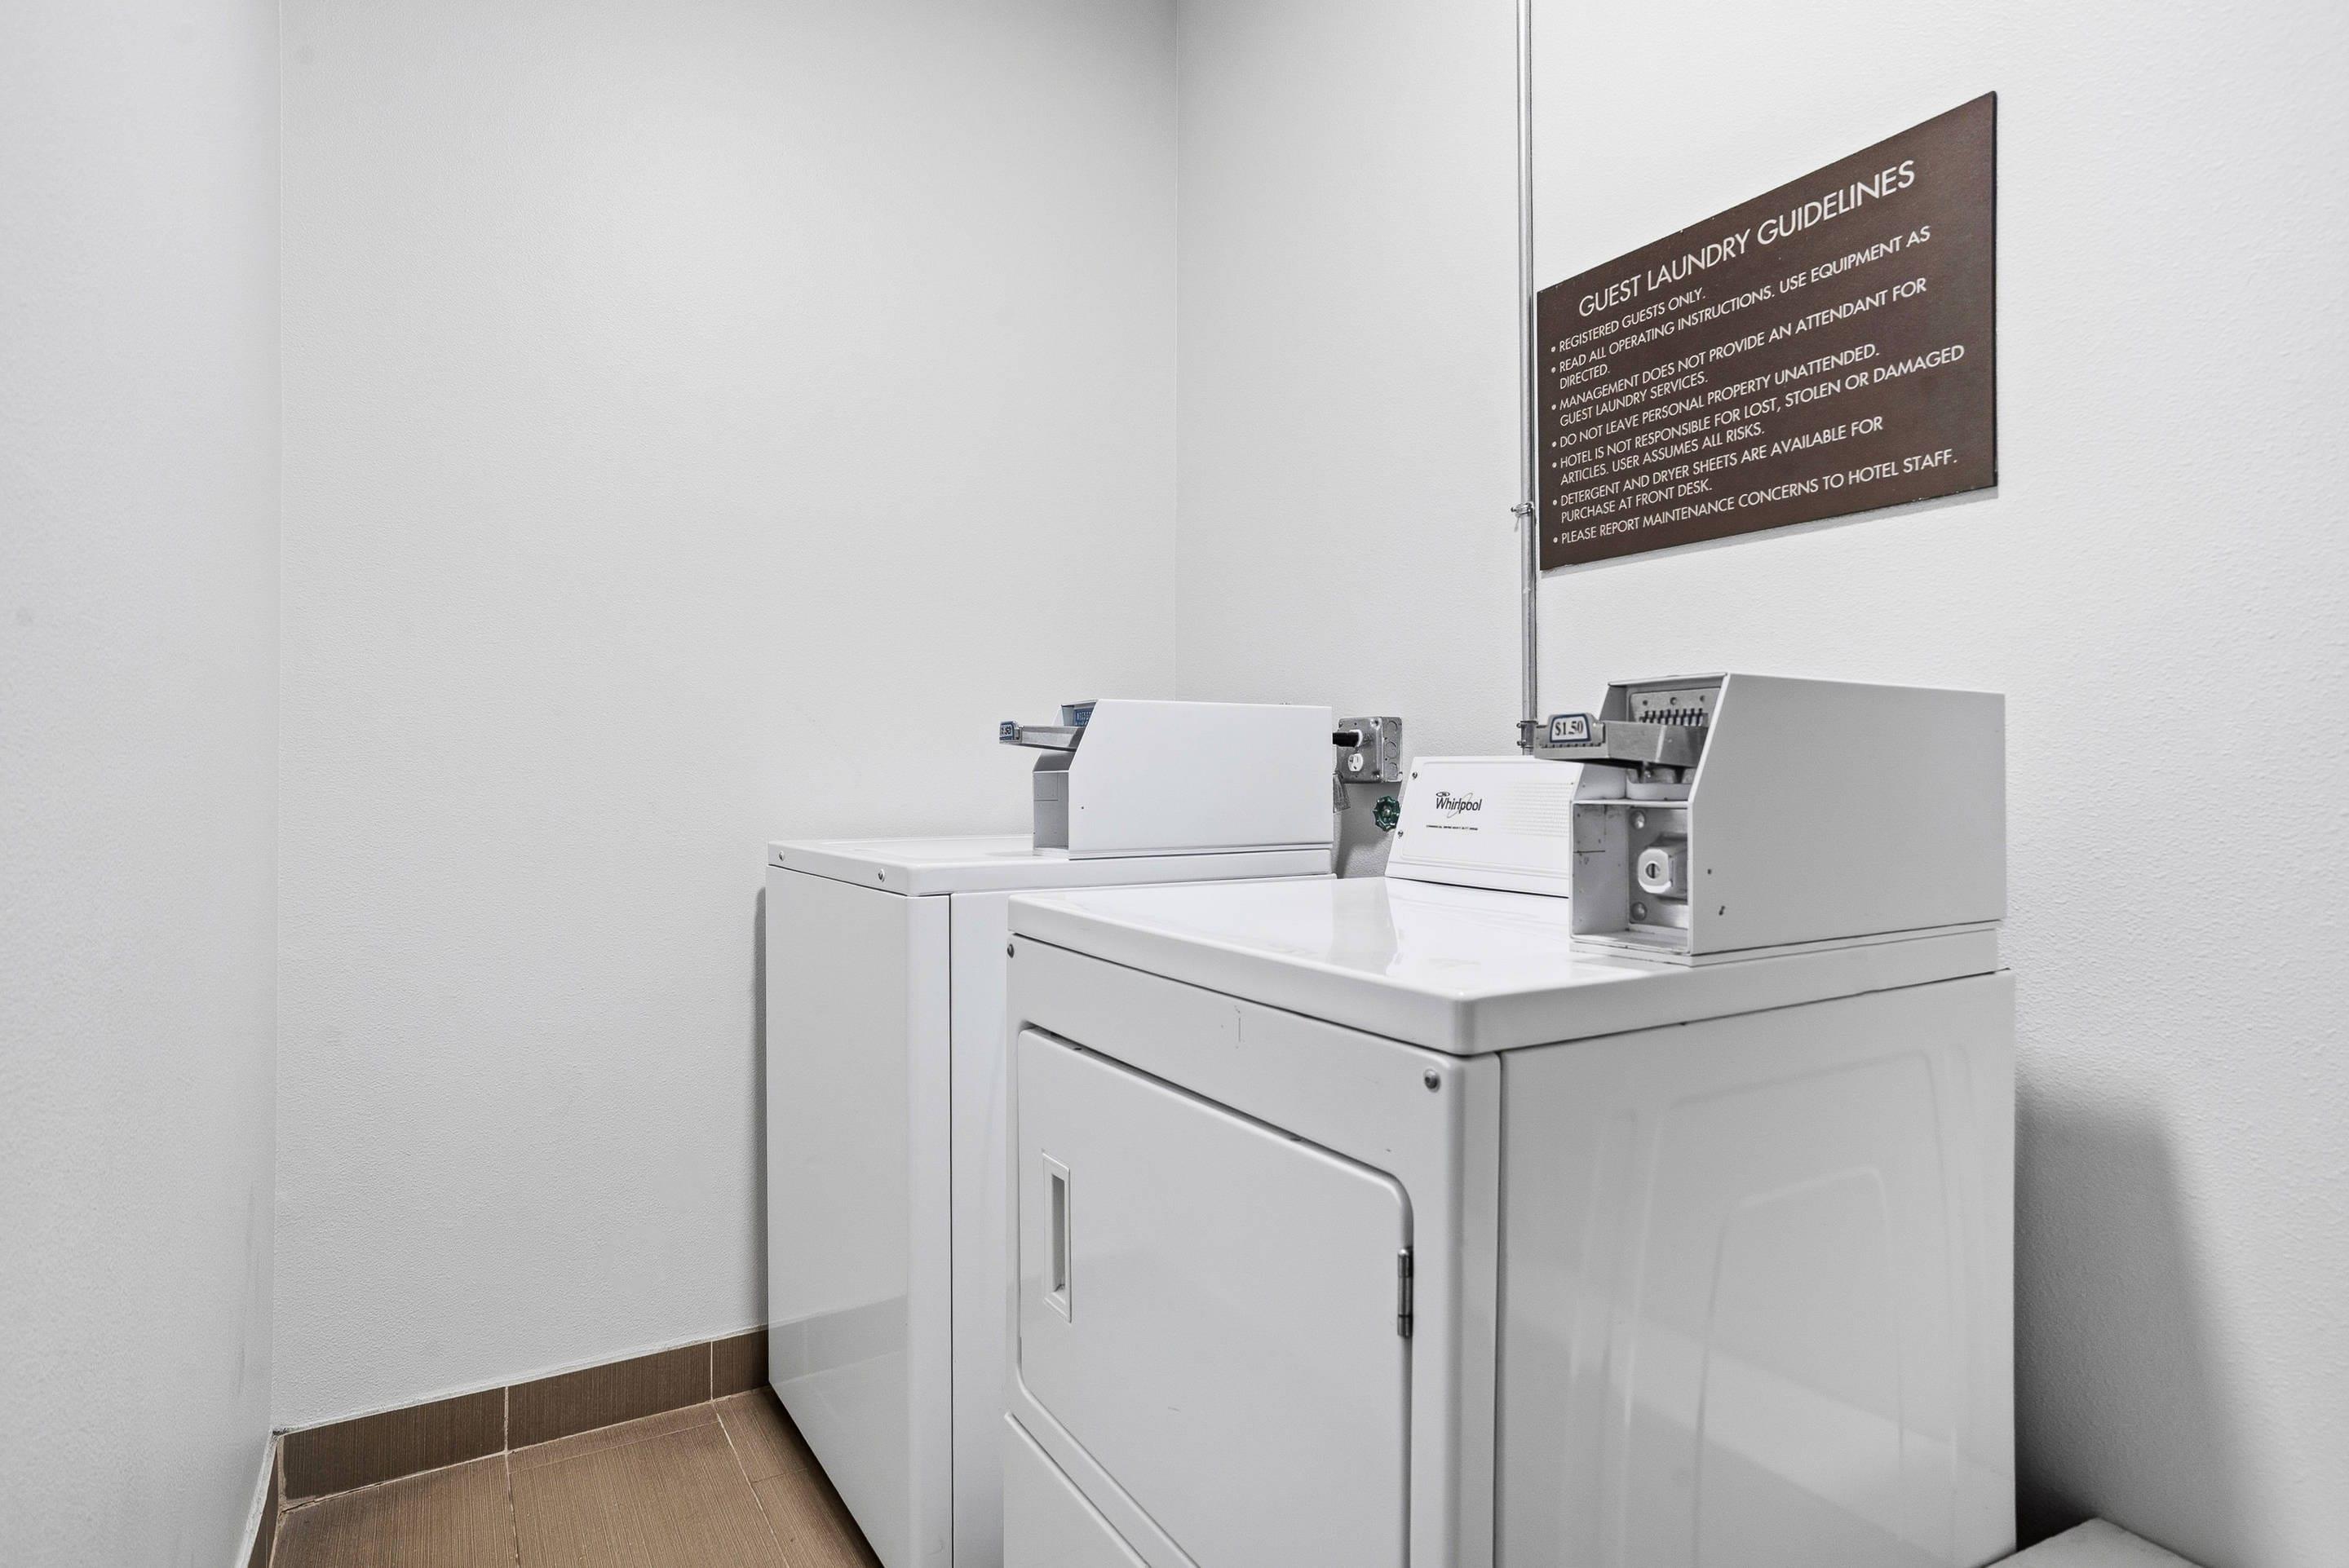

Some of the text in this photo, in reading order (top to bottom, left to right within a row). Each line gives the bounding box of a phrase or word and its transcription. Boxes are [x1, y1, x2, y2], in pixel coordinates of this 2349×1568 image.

[1579, 161, 1914, 316] GUEST LAUNDRY GUIDELINES
[1559, 226, 1930, 373] READ ALL OPERATING INSTRUCTIONS. USE EQUIPMENT AS
[1559, 287, 1705, 352] REGISTERED GUESTS ONLY.
[1559, 278, 1927, 410] MANAGEMENT DOES NOT PROVIDE AN ATTENDANT FOR
[1560, 364, 1610, 389] DIRECTED.
[1560, 344, 1879, 448] DO NOT LEAVE PERSONAL PROPERTY UNATTENDED.
[1560, 371, 1708, 426] GUEST LAUNDRY SERVICES.
[1561, 345, 1964, 468] HOTEL IS NOT RESPONSIBLE FOR LOST, STOLEN OR DAMAGED
[1560, 422, 1764, 485] ARTICLES. USER ASSUMES ALL RISKS.
[1561, 417, 1882, 506] DETERGENT AND DRYER SHEETS ARE AVAILABLE FOR
[1562, 449, 1957, 544] PLEASE REPORT MAINTENANCE CONCERNS TO HOTEL STAFF.
[1562, 479, 1712, 523] PURCHASE AT FRONT DESK.
[1555, 721, 1584, 736] $1.50
[1436, 797, 1483, 815] Whirlpool
